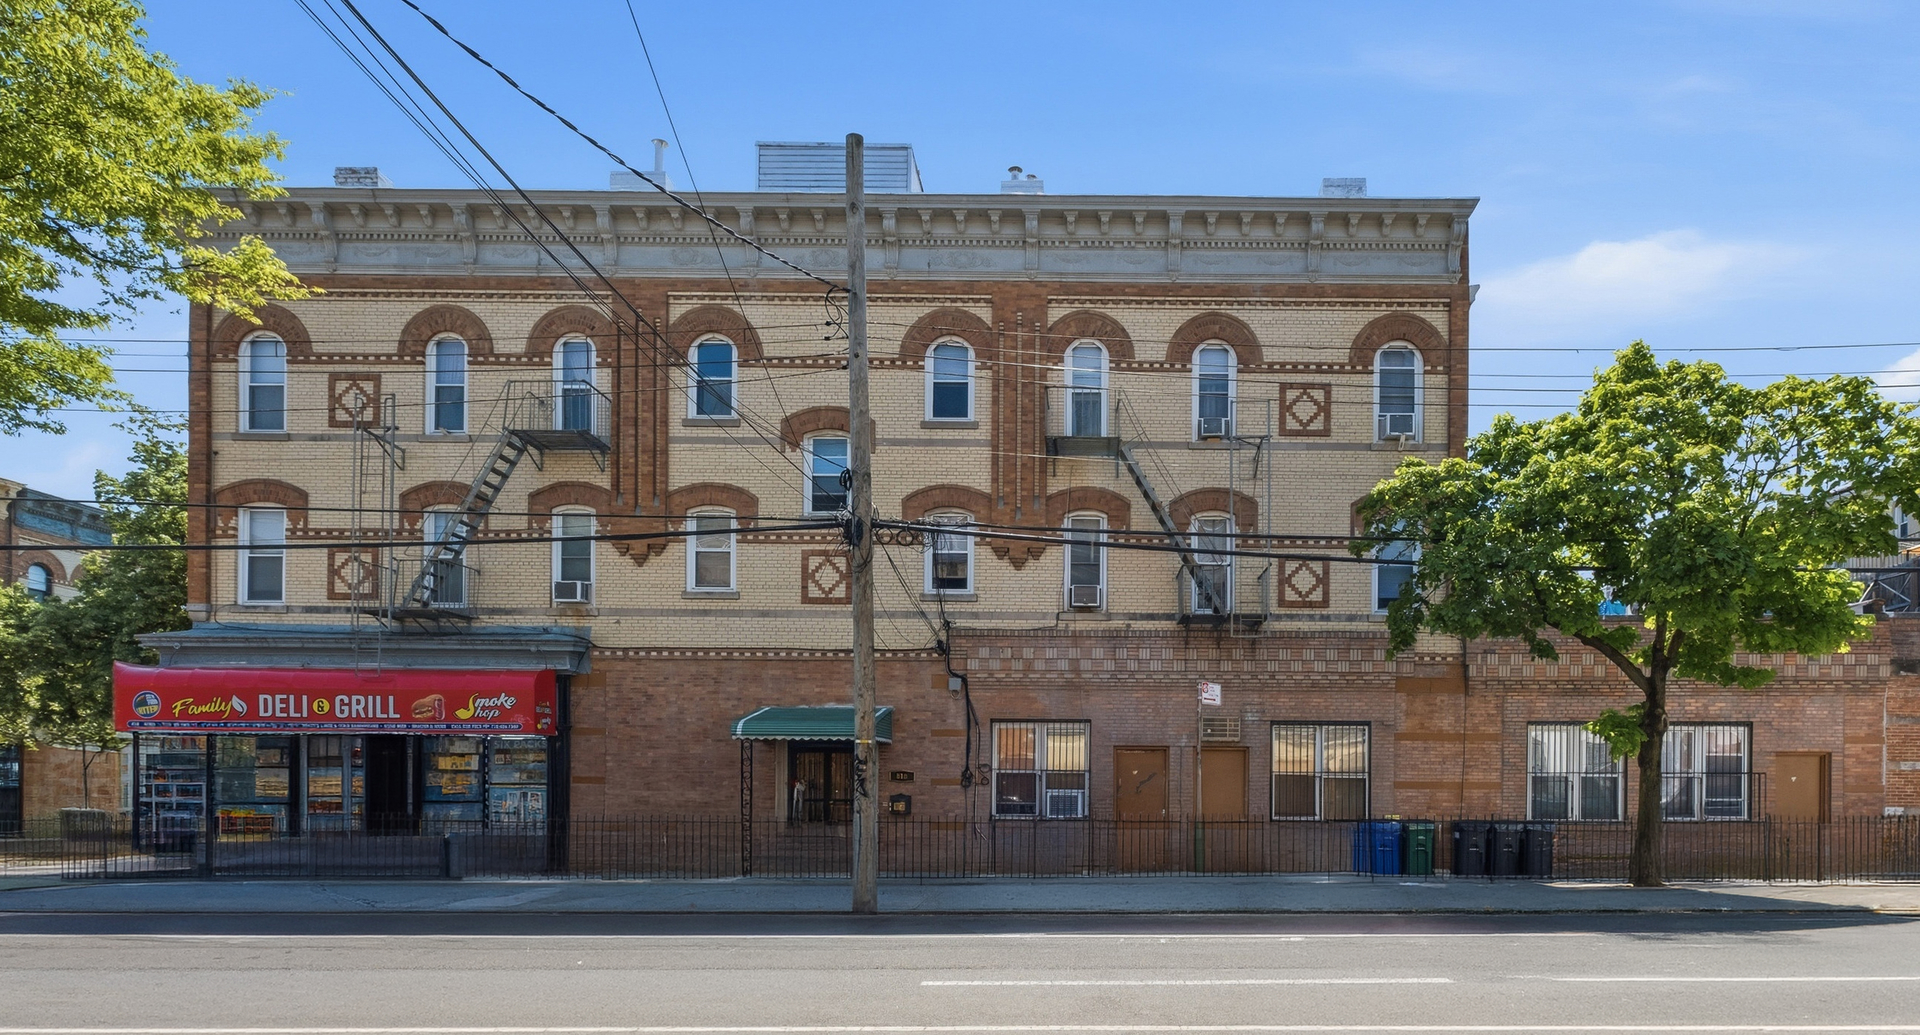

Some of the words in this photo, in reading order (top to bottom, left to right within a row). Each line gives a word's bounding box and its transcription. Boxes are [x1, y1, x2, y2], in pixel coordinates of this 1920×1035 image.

[172, 697, 233, 719] Family
[258, 694, 308, 718] DELI
[314, 699, 328, 713] &
[334, 694, 400, 719] GRILL
